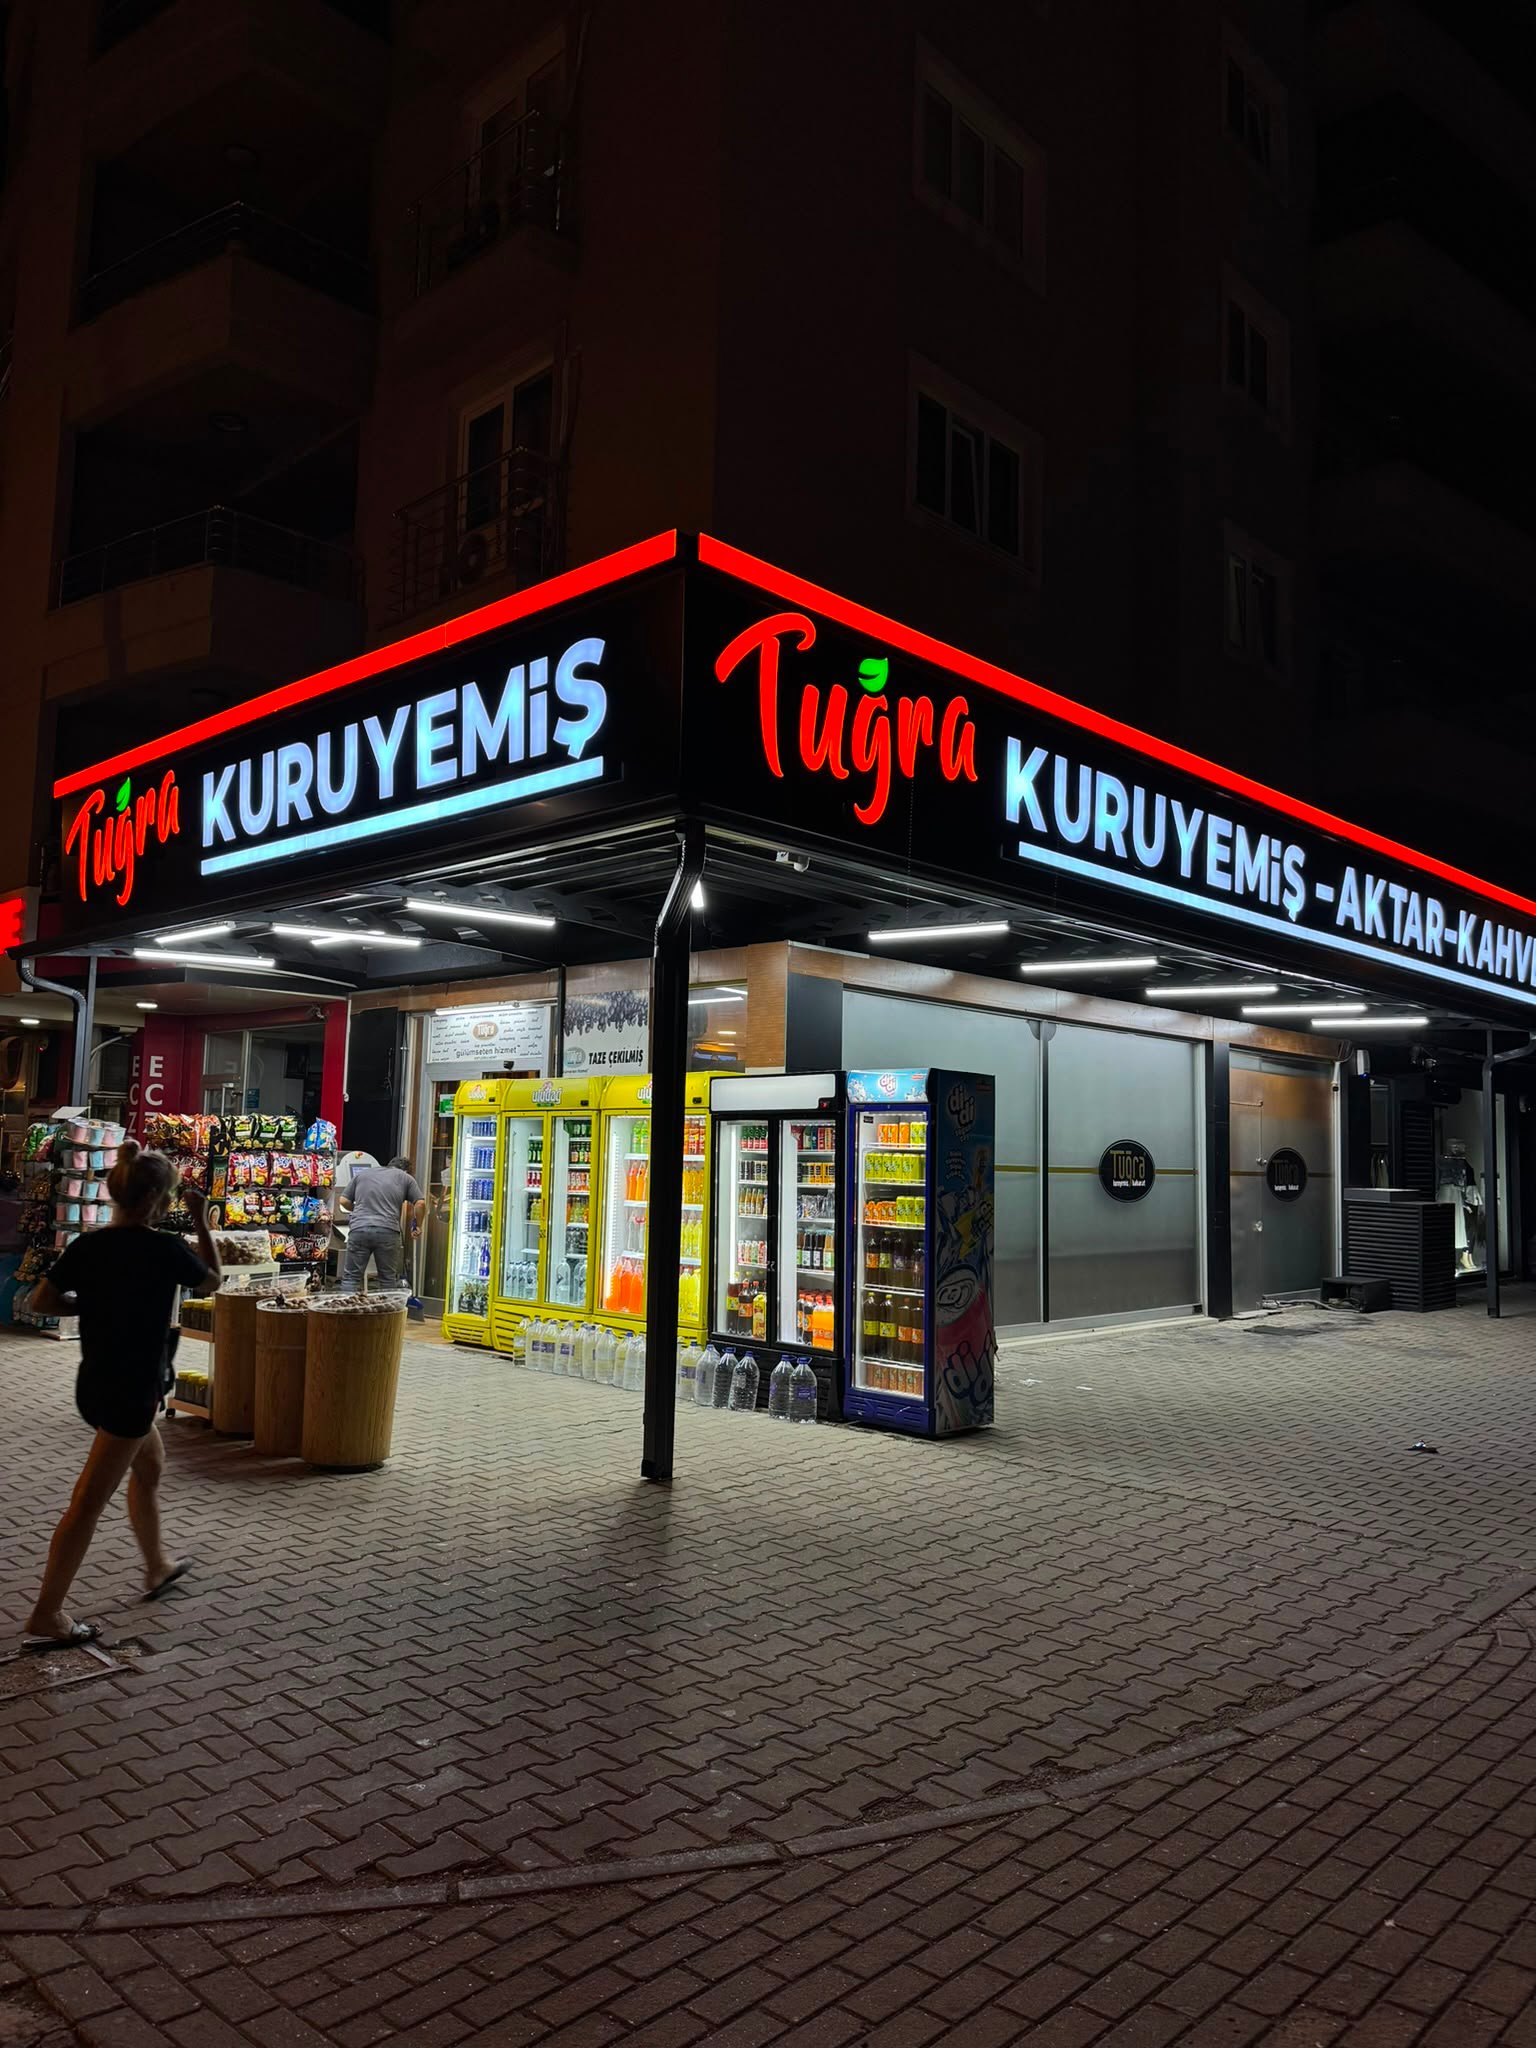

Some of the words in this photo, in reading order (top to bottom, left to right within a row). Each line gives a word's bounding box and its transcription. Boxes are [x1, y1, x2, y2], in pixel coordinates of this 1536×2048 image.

[714, 611, 979, 825] Tuğra
[64, 769, 181, 907] Tuğra
[589, 1051, 607, 1065] TAZE
[608, 1046, 644, 1068] ÇEKİLMİŞ
